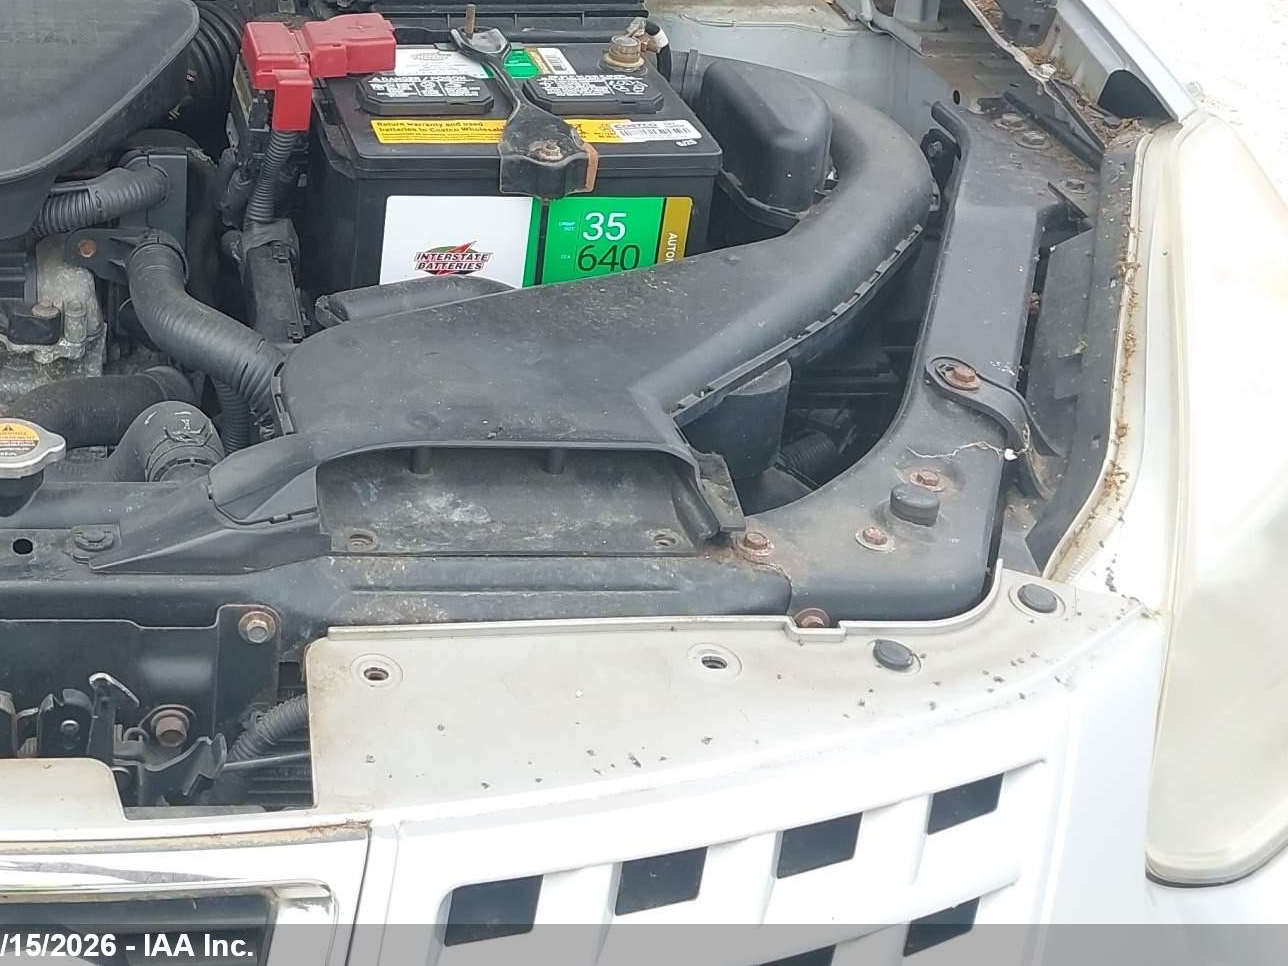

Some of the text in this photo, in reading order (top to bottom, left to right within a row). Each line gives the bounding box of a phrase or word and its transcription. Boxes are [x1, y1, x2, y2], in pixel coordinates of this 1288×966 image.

[582, 212, 628, 241] 35
[416, 253, 489, 261] INTERSTATE
[418, 262, 483, 270] BATTERIES
[577, 244, 641, 272] 640
